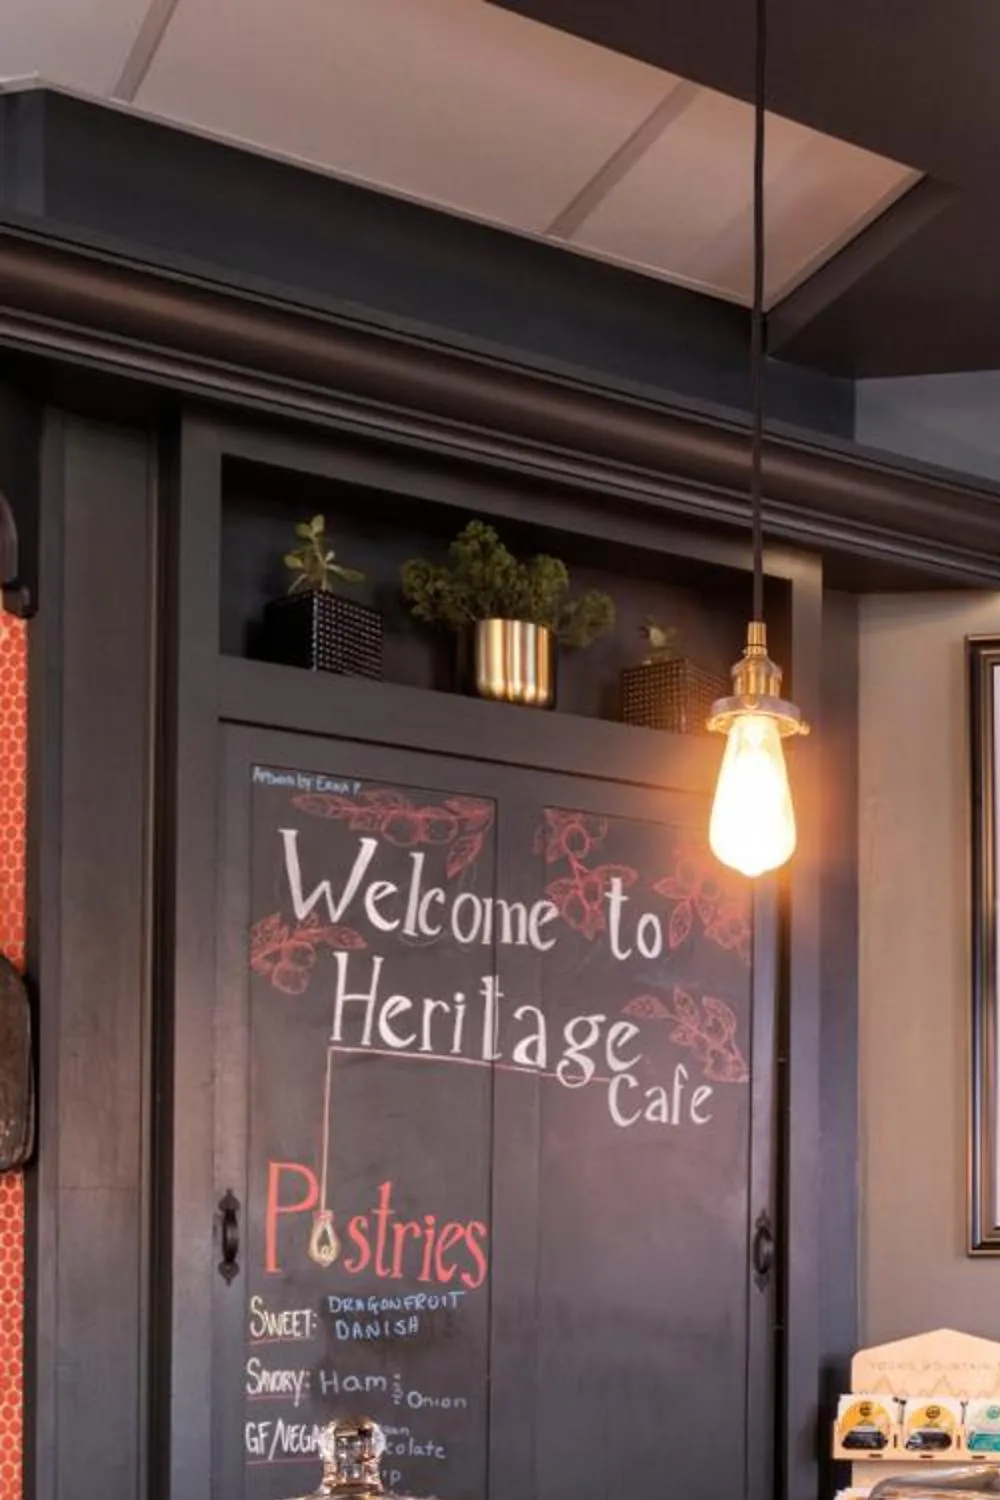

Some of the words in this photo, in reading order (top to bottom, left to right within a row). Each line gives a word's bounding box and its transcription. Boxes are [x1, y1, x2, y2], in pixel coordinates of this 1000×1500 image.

[278, 828, 560, 951] Welcome
[605, 877, 662, 961] to
[330, 951, 643, 1088] Heritage
[328, 1291, 466, 1314] DRAGONFRUIT
[335, 1316, 419, 1340] DANISH
[319, 1369, 388, 1395] Ham
[407, 1391, 467, 1409] Onion
